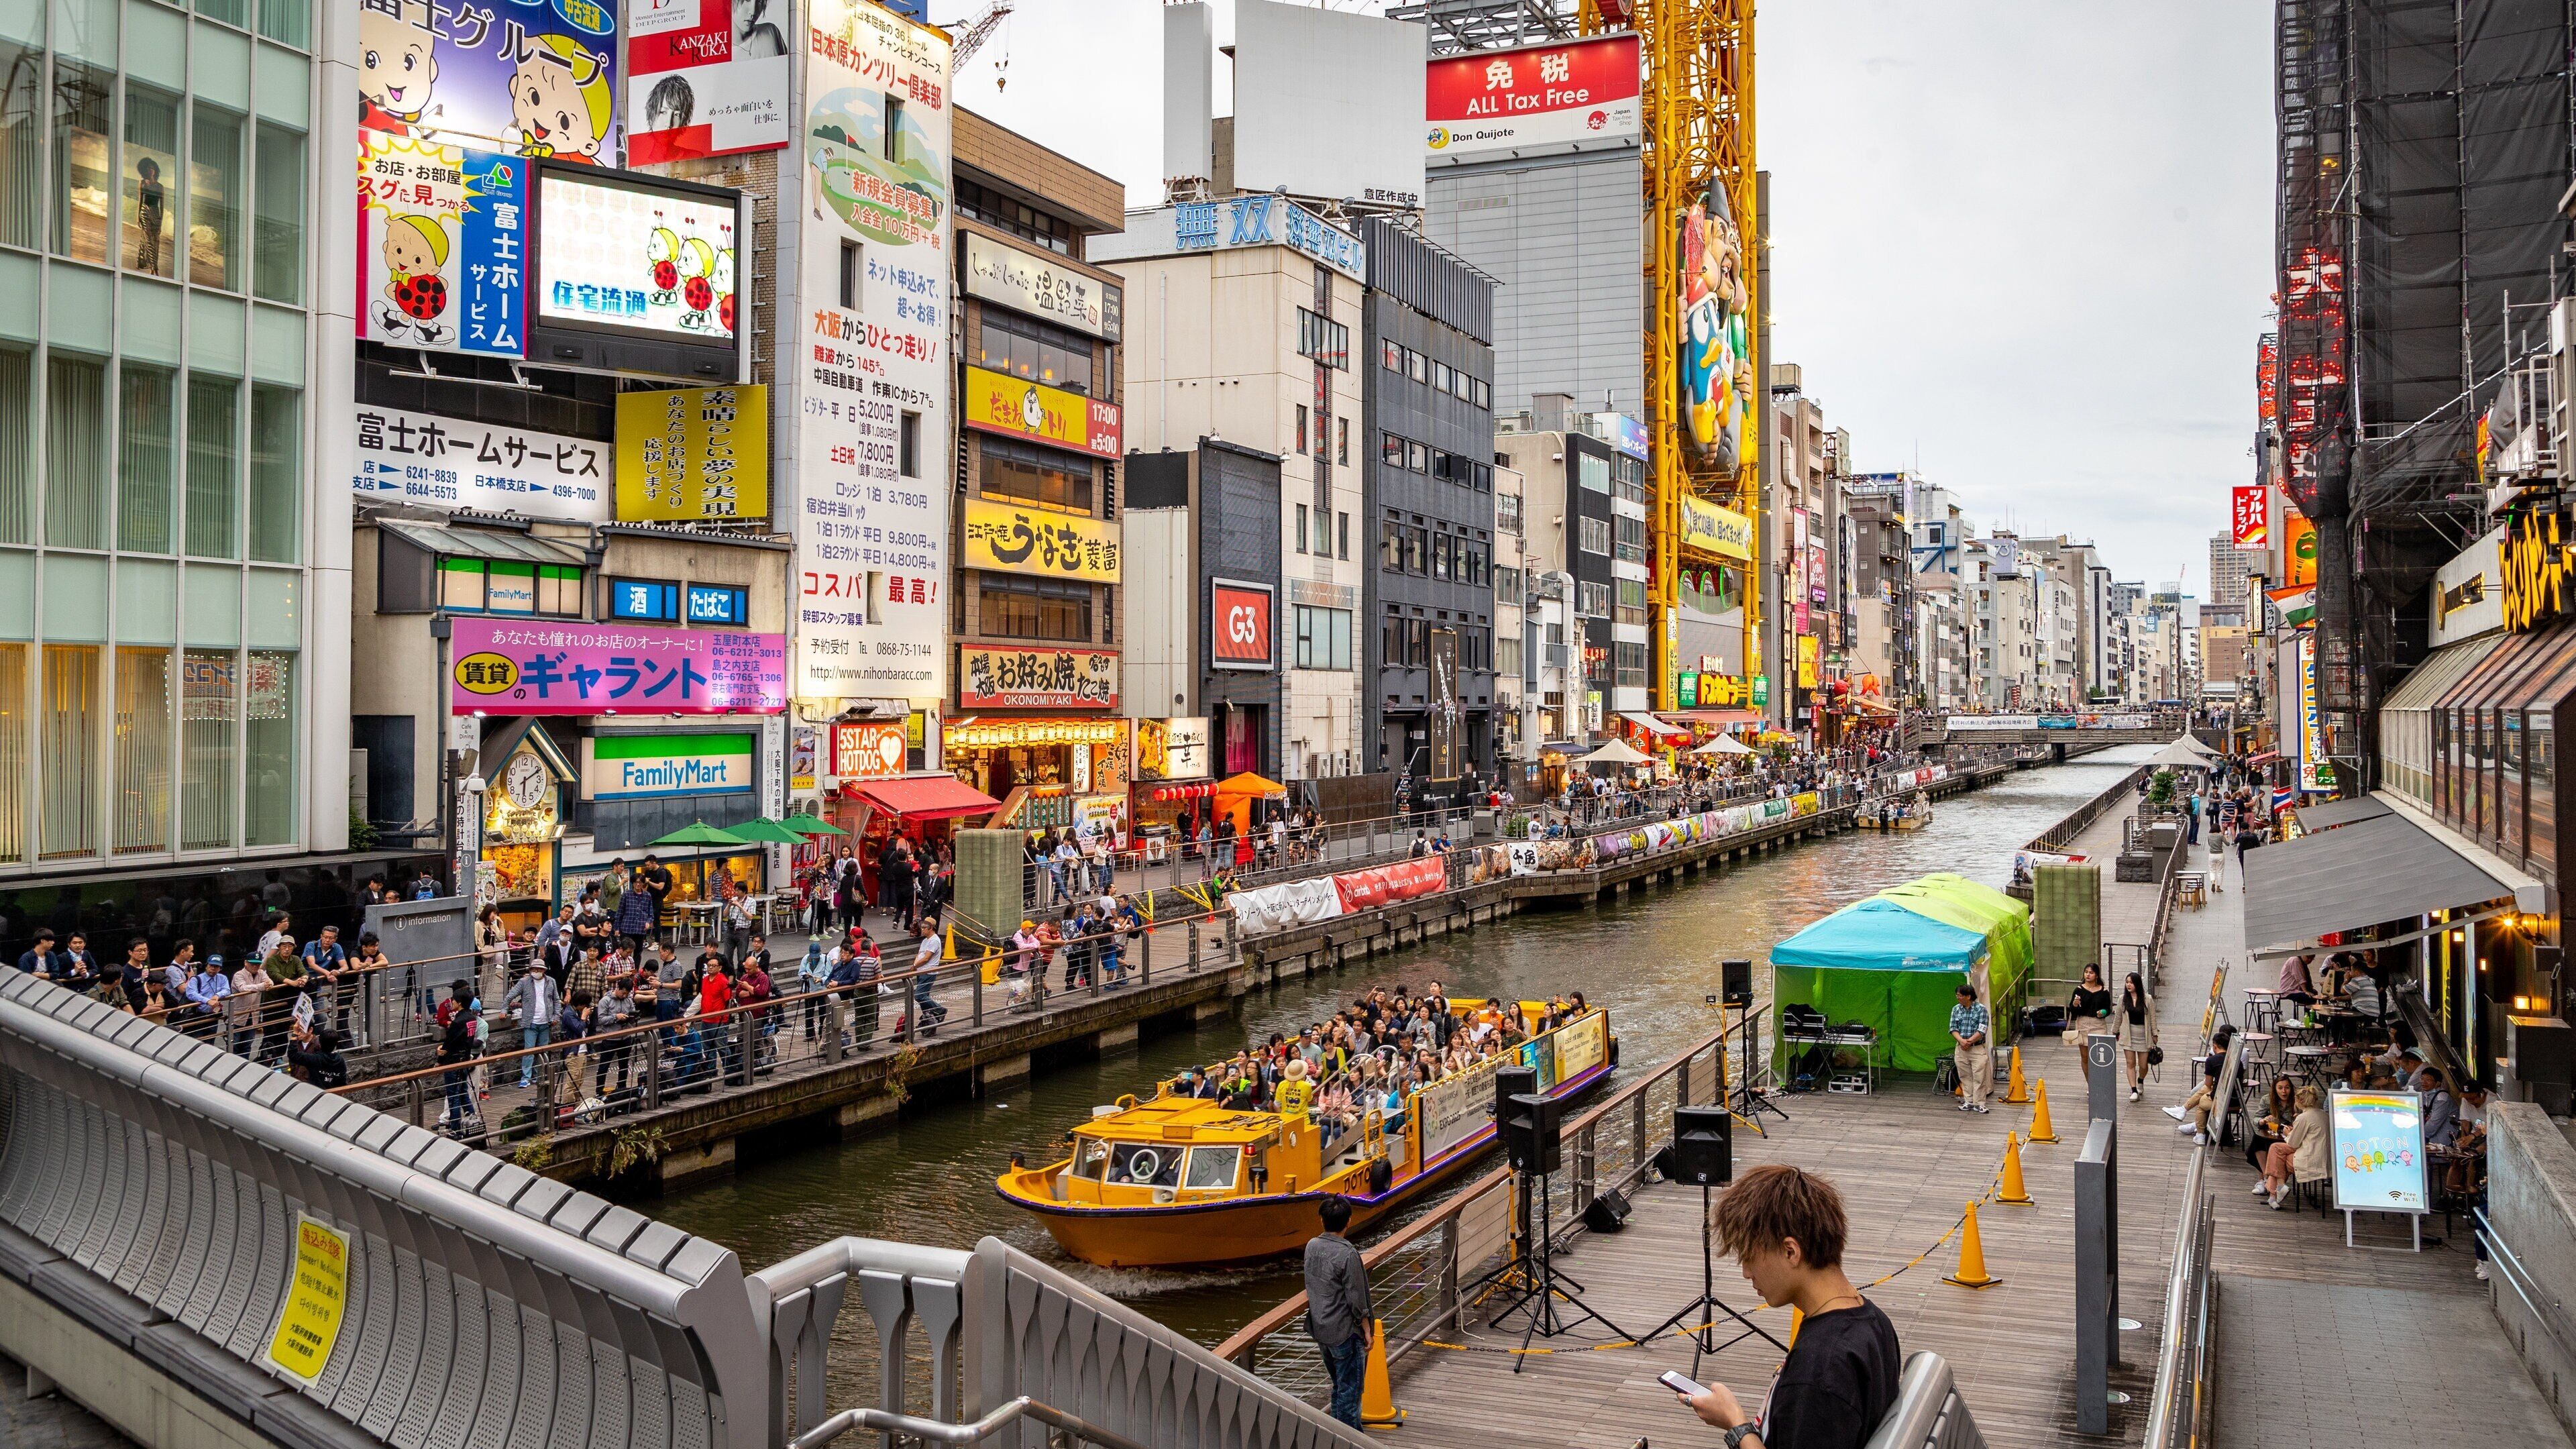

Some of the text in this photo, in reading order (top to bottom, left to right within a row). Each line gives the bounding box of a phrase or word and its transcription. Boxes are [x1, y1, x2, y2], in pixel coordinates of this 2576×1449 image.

[635, 15, 686, 28] DEEP GROUP
[653, 9, 686, 18] Entertainment
[669, 32, 728, 56] KANZAKI
[692, 43, 728, 64] RUKA
[812, 28, 942, 111] 日本原カンツリー倶楽部
[708, 99, 773, 117] めっちゃ面白いを
[1466, 87, 1590, 116] ALL Tax Free
[1611, 113, 1632, 123] Tax-free
[1618, 119, 1632, 127] Shop
[1452, 127, 1515, 144] Don Quijote
[358, 175, 470, 213] スグに見つかる
[1363, 187, 1419, 204] 意匠作成中
[1175, 195, 1274, 250] 無双
[492, 202, 519, 350] 富士ホーム
[973, 252, 1030, 291] しゃぶしゃぶ
[470, 264, 488, 340] サービス
[551, 279, 649, 318] 住宅流通
[1034, 270, 1087, 323] 温野菜
[1104, 302, 1119, 317] 17:00
[814, 368, 863, 393] 中国自動車道
[859, 399, 894, 424] 5,200円
[989, 391, 1023, 427] だまれ
[1091, 403, 1117, 425] 17:00
[357, 411, 600, 478] 富士ホームサービス
[667, 394, 686, 509] あなたのお店づくり
[700, 389, 737, 518] 素晴らしい夢の実現
[830, 441, 894, 466] 土日祝 7,800円
[1091, 433, 1117, 455] 翌5:00
[406, 466, 458, 484] 6241-8839
[643, 437, 663, 501] 応援します
[406, 482, 458, 500] 6644-5573
[475, 474, 596, 501] 日本橋支店 4396-7000
[836, 482, 861, 498] ロッジ
[888, 490, 927, 509] 3,780円
[806, 497, 865, 520] 宿泊弁当パック
[2237, 495, 2249, 535] ドラッグ
[2249, 489, 2265, 525] ツルハ
[991, 513, 1084, 572] うなぎ
[488, 588, 532, 602] FamilyMart
[804, 572, 863, 600] コスパ
[629, 587, 647, 614] 酒
[690, 590, 729, 619] たばこ
[802, 610, 863, 627] 幹部スタッフ募集
[1228, 605, 1257, 645] G3
[712, 634, 761, 647] 玉屋町本店
[810, 638, 849, 657] 予約受付
[876, 643, 931, 657] 0868-75-1144
[712, 647, 782, 658] 06-6212-3013
[464, 662, 511, 685] 賃貸
[520, 651, 708, 700] ギャラント
[712, 659, 761, 672] 島之内支店
[810, 664, 932, 683] http://www.nihonbaracc.com
[970, 652, 990, 678] 本場
[997, 651, 1076, 692] お好み焼
[712, 672, 782, 682] 06-6765-1306
[712, 683, 761, 694] 宗右衛門町支店
[975, 674, 996, 700] 大阪
[1077, 672, 1110, 704] たこ焼
[1681, 676, 1695, 692] 薬
[1754, 680, 1768, 693] 薬
[514, 688, 527, 700] の
[712, 698, 782, 706] 06-6211-2727
[1004, 694, 1072, 706] OKONOMIYAKI
[839, 727, 877, 750] 5STAR
[875, 726, 905, 740] SARANG
[907, 739, 923, 747] Hotdog
[839, 749, 880, 772] HOTDOG
[623, 759, 727, 789] FamilyMart
[1512, 847, 1537, 867] 千房
[1354, 884, 1371, 898] airbnb
[408, 913, 451, 926] information
[2342, 1136, 2408, 1155] DOTON
